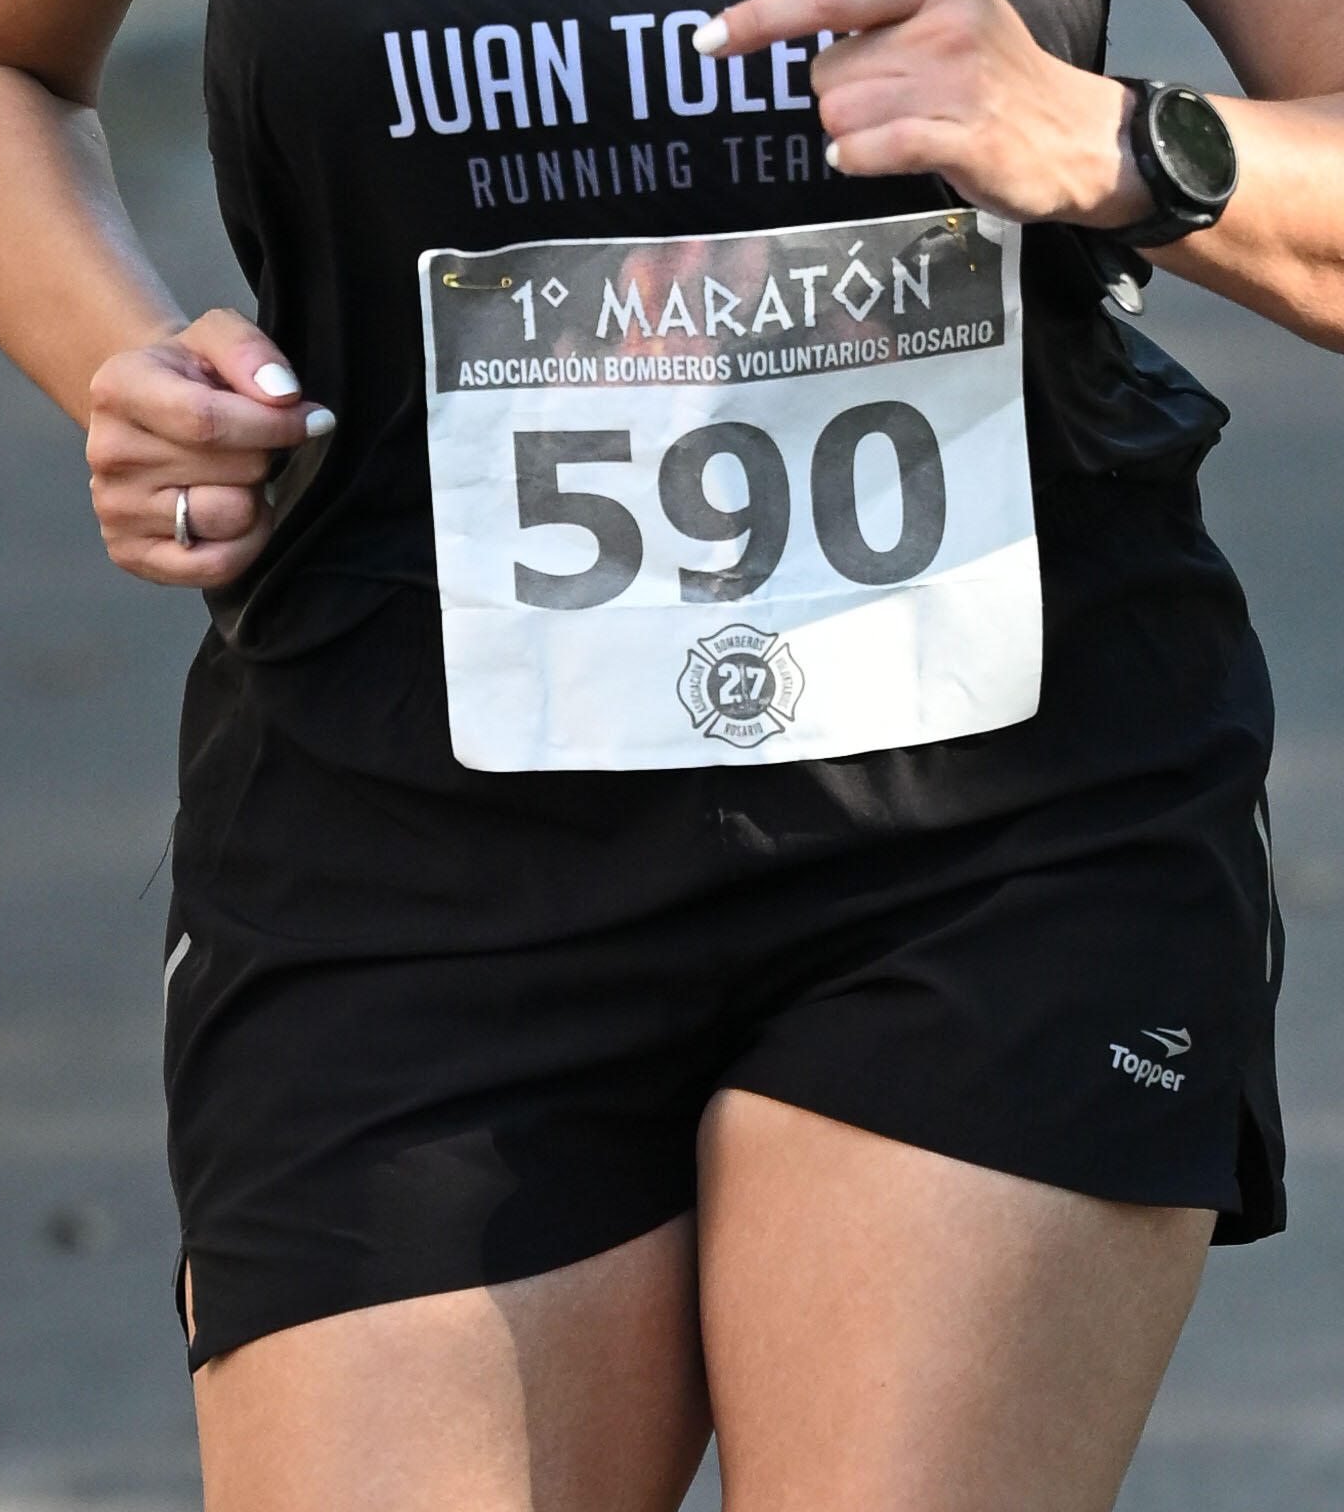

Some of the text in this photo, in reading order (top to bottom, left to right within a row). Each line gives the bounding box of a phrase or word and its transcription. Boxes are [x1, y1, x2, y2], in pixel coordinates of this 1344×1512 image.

[383, 9, 859, 139] JUAN TOLE
[467, 140, 693, 209] RUNNING
[595, 239, 932, 340] MARATÓN
[458, 319, 995, 387] ASOCIACIÓN BOMBEROS VOLUNTARIOS ROSARIO
[512, 399, 947, 610] 590
[717, 662, 767, 705] 27
[1109, 1043, 1187, 1092] Topper
